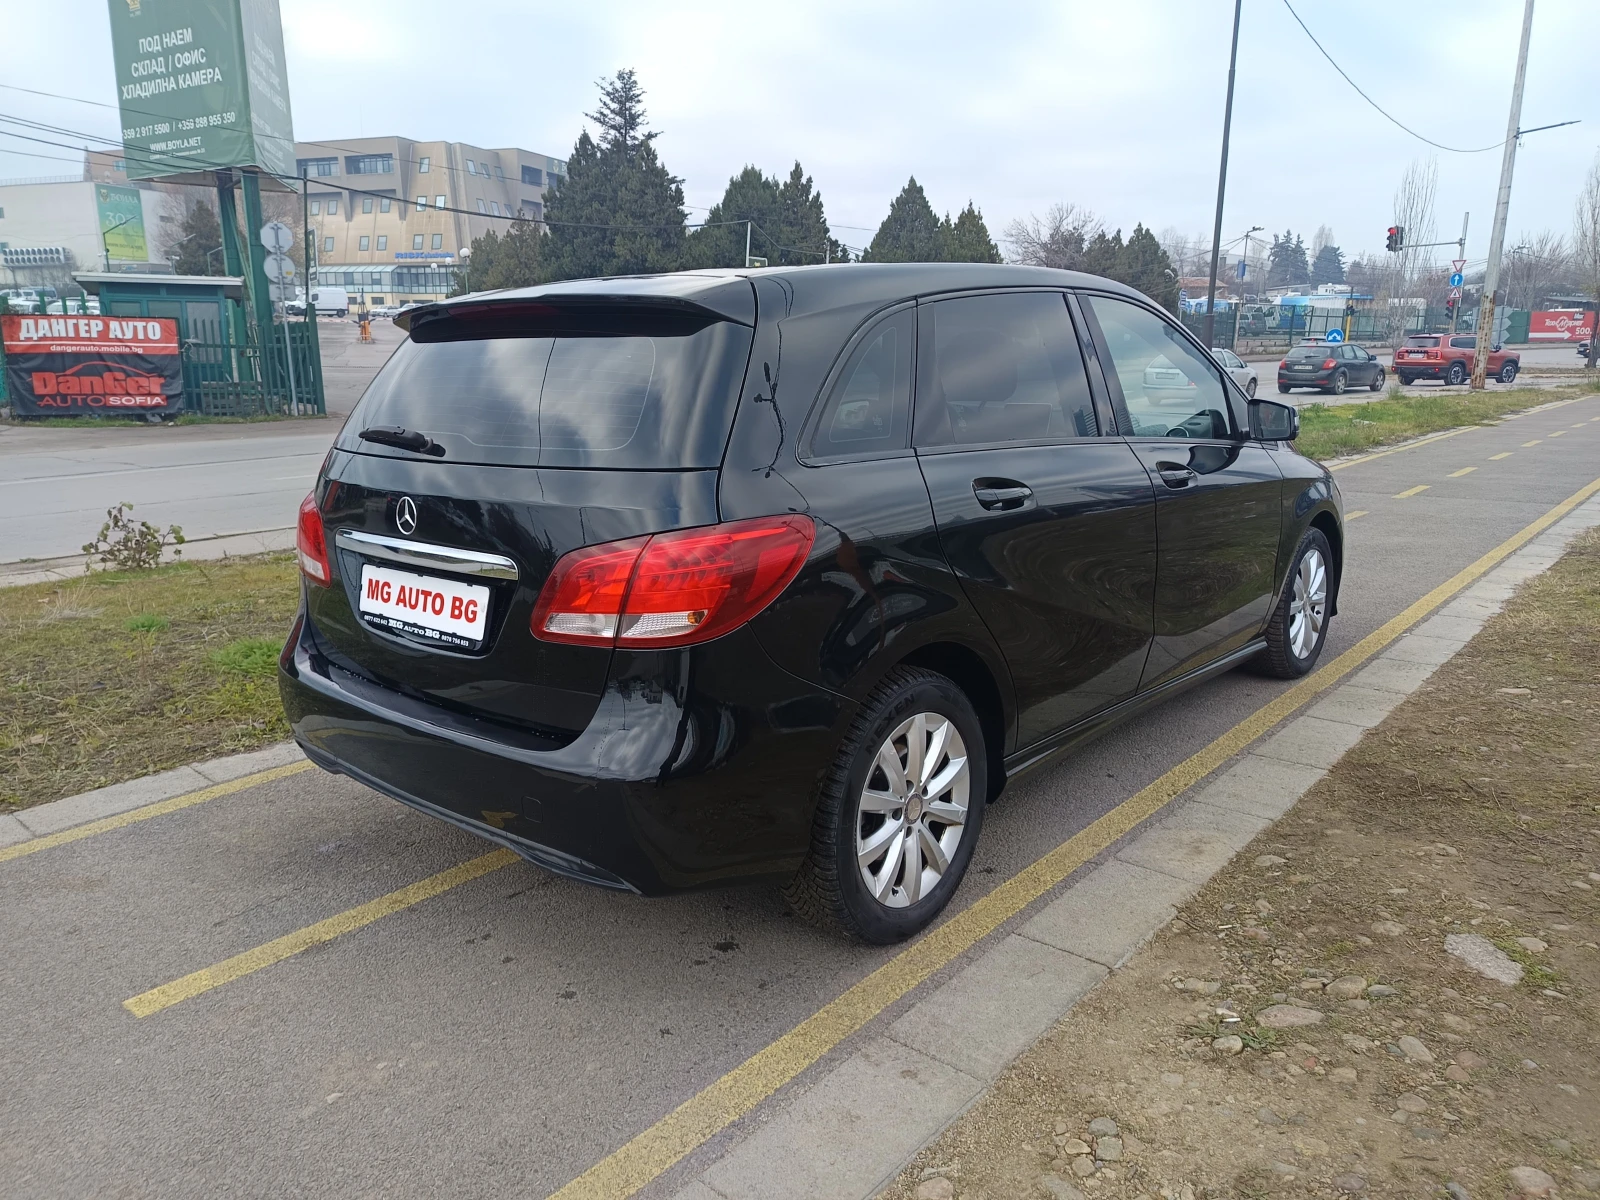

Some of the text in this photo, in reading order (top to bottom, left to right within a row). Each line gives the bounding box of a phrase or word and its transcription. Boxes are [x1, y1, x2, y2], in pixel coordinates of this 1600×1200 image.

[139, 27, 193, 53] ПОД НАЕМ
[131, 57, 166, 78] СКЛАД
[174, 47, 206, 68] ОФИС
[121, 67, 223, 100] ХЛАДИЛНА КАМЕРА
[122, 127, 135, 140] 359
[136, 127, 141, 138] 2
[141, 125, 153, 137] 917
[154, 122, 170, 135] 5500
[178, 118, 195, 131] +359
[208, 114, 221, 126] 955
[223, 111, 236, 124] 350
[149, 136, 202, 152] WWW.BOYLA.NET
[105, 211, 126, 228] 30
[19, 318, 161, 341] ДАНГЕР АУТО
[50, 344, 143, 354] dangerauto.mobile.bg
[31, 372, 165, 395] DanGer
[37, 395, 165, 407] AUTO SOFIA
[367, 578, 478, 624] MG AUTO BG
[388, 618, 404, 630] MG
[403, 625, 425, 635] AUTO
[424, 628, 441, 639] BG
[864, 693, 915, 756] NEXEN
